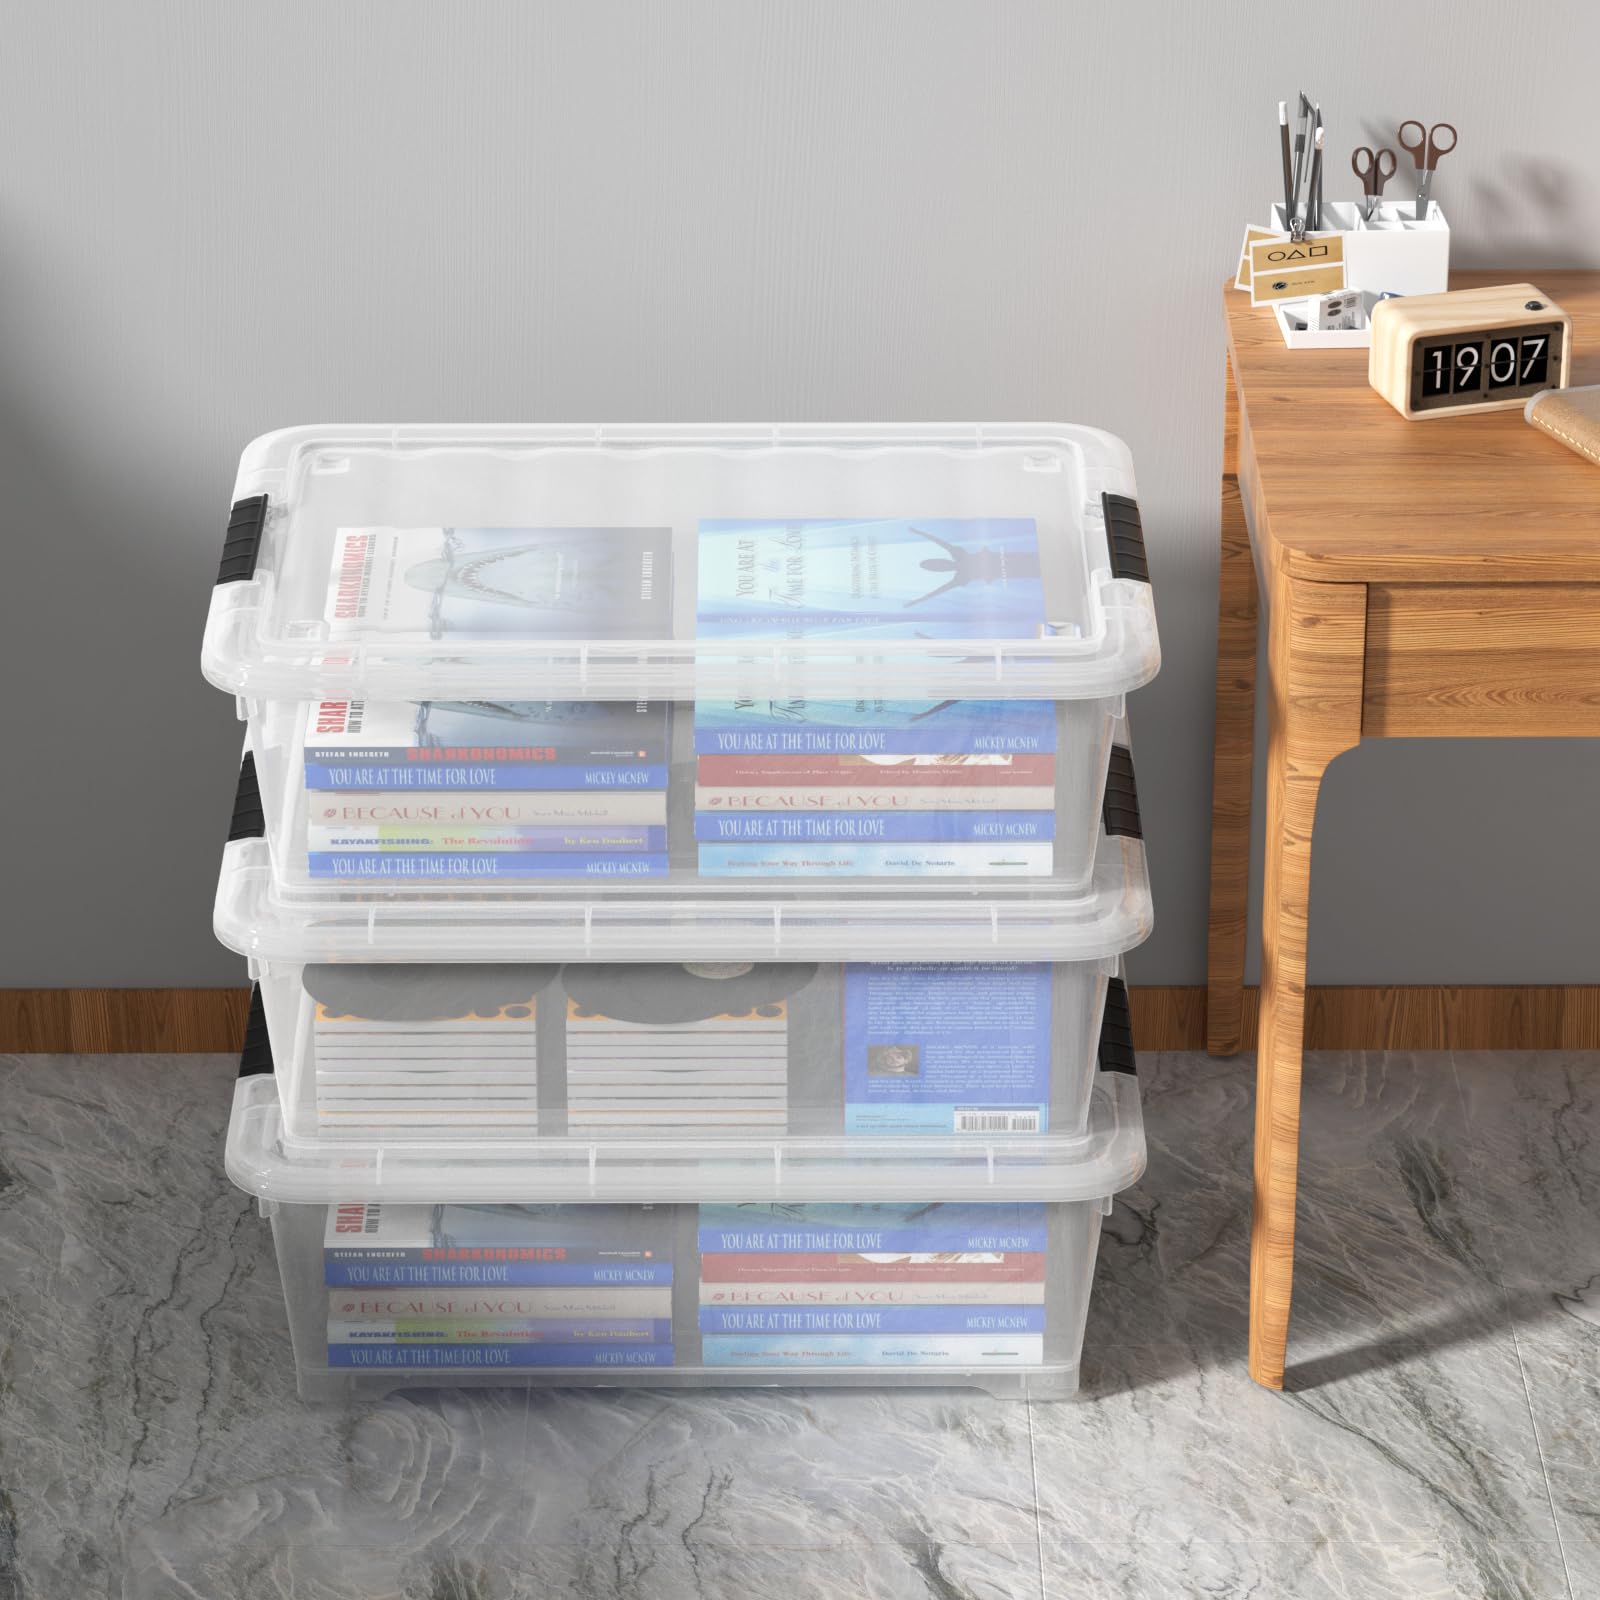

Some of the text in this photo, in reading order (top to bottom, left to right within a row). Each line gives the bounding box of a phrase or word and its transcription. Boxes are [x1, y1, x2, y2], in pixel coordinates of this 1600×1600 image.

[1432, 338, 1546, 390] 1907
[335, 535, 370, 618] SHARKONOMICS
[718, 733, 885, 750] YOU ARE AT THE TIME FOR LOVE
[975, 736, 1006, 750] MICKEY
[328, 768, 496, 785] YOU ARE AT THE TIME FOR LOVE
[585, 771, 616, 784] MICKEY
[342, 807, 447, 819] BECAUSE
[469, 807, 521, 819] YOU
[718, 819, 885, 836] YOU ARE AT THE TIME FOR LOVE
[973, 823, 1005, 836] MICKEY
[332, 858, 497, 874] YOU ARE AT THE TIME FOR LOVE
[721, 1233, 882, 1249] YOU ARE AT THE TIME FOR LOVE
[967, 1237, 997, 1249] MICKEY
[347, 1265, 509, 1282] YOU ARE AT THE TIME FOR LOVE
[593, 1270, 623, 1281] MICKEY
[721, 1313, 882, 1329] YOU ARE AT THE TIME FOR LOVE
[966, 1317, 996, 1329] MICKEY
[351, 1349, 511, 1364] YOU ARE AT THE TIME FOR LOVE
